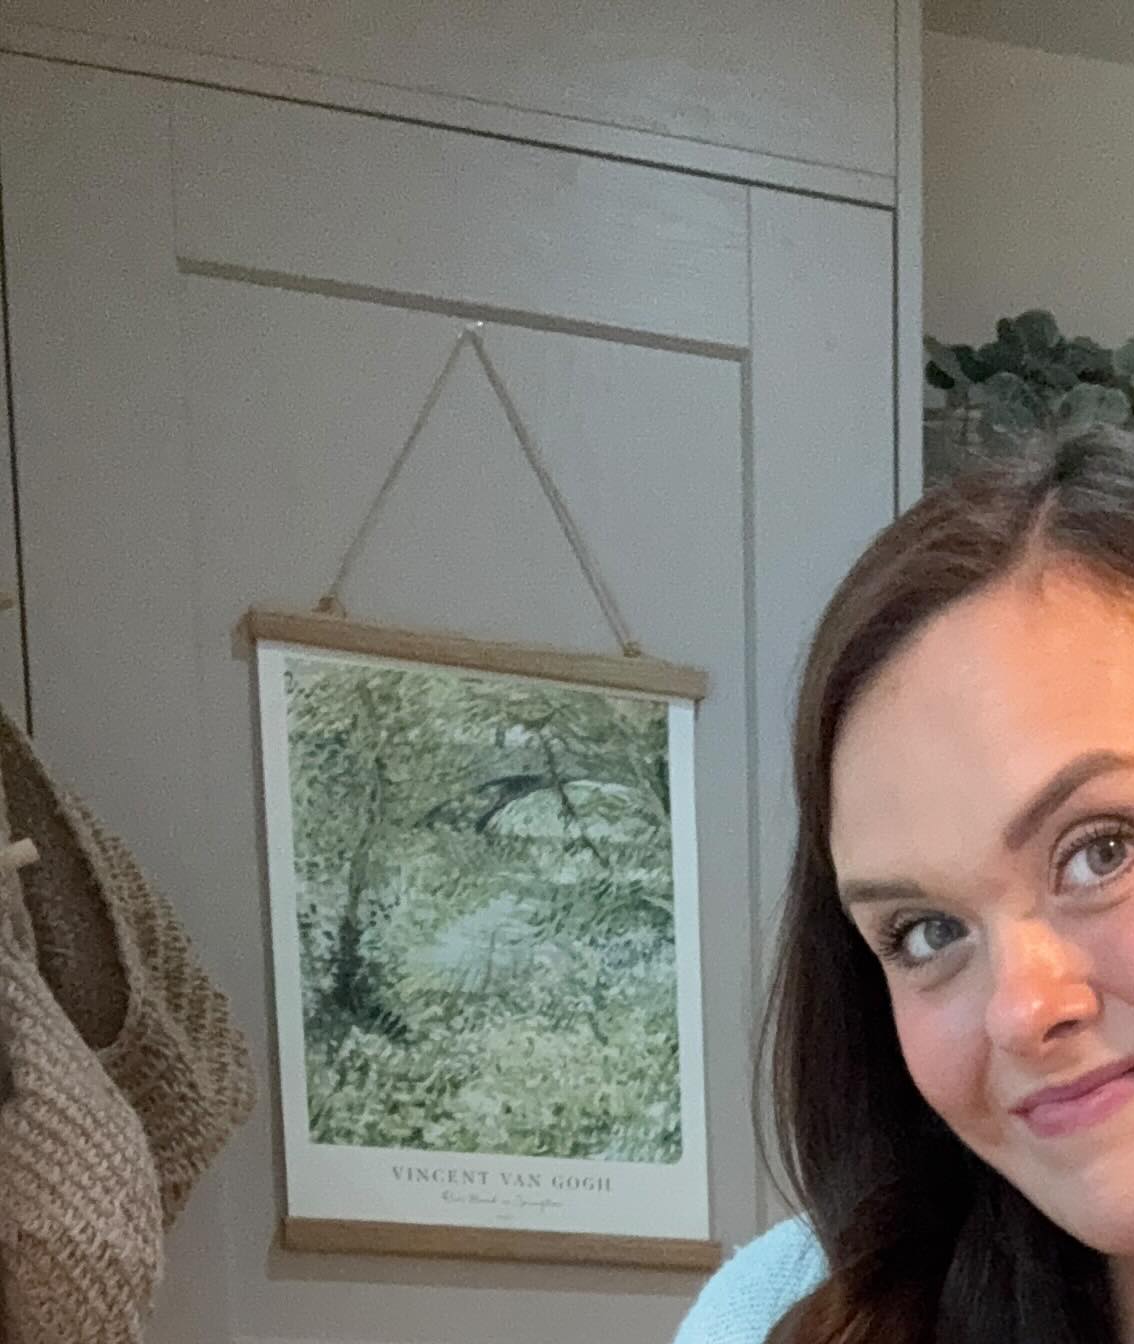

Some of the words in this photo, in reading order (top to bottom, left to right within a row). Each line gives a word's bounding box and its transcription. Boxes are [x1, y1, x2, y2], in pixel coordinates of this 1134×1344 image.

[391, 1165, 490, 1186] VINCENT
[499, 1172, 543, 1189] VAN
[551, 1175, 613, 1193] GOGH
